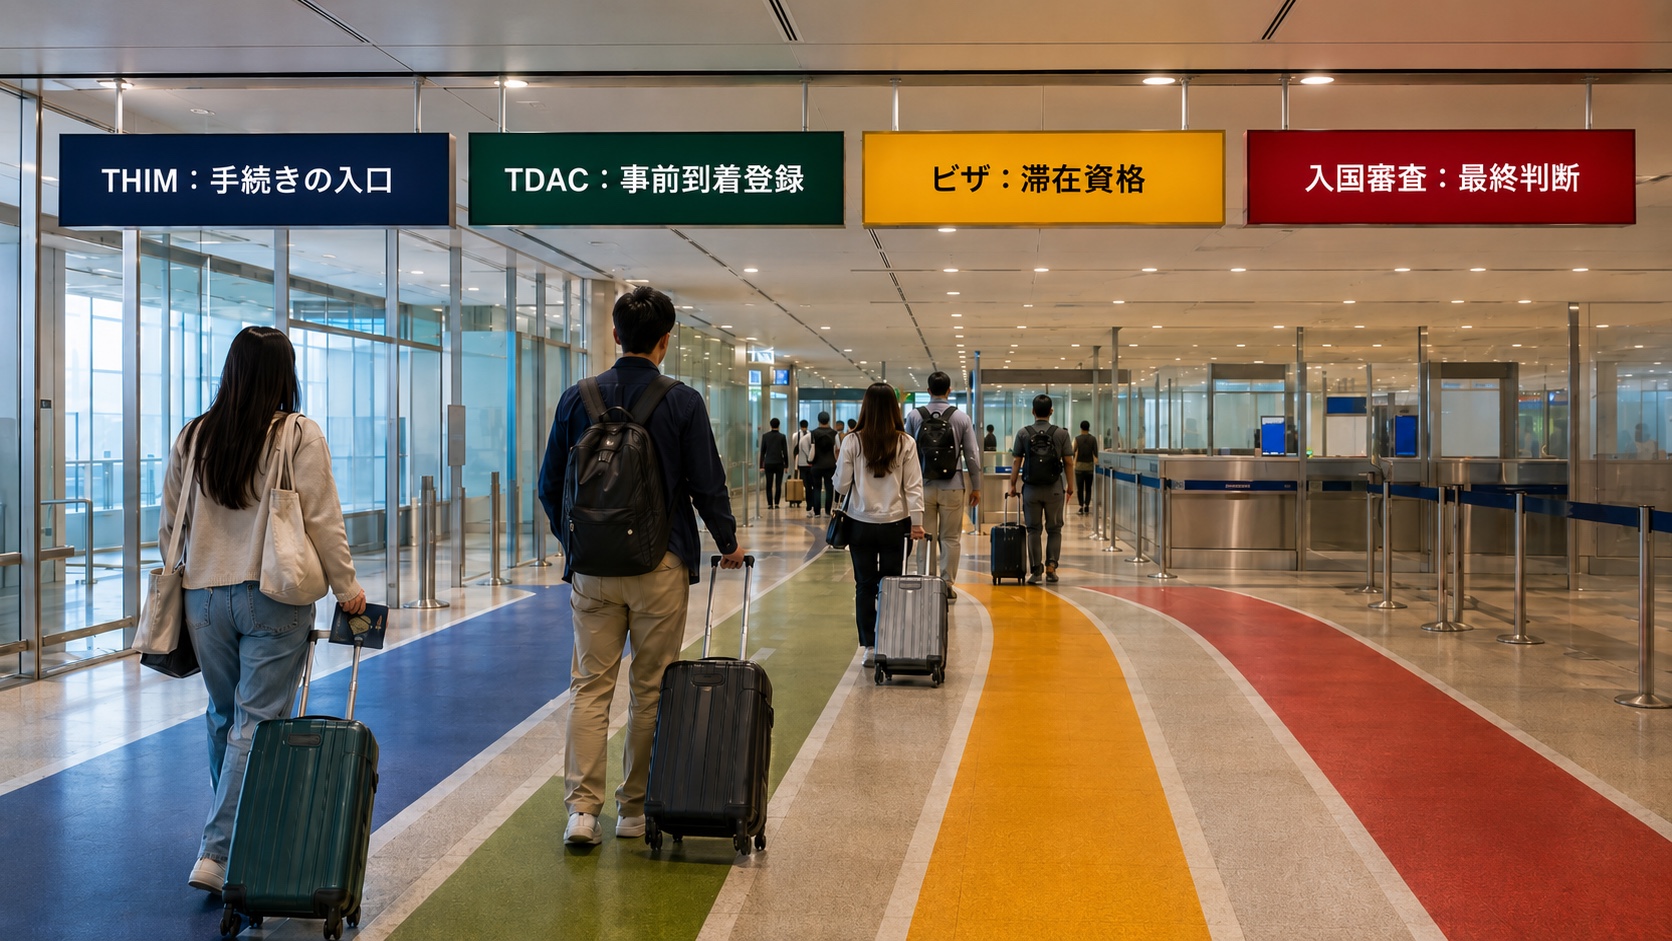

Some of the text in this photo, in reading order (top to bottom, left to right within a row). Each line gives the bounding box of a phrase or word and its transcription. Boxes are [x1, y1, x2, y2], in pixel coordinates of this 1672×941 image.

[933, 163, 1146, 194] ビザ：滞在資格
[1305, 162, 1580, 193] 入国審査：最終判断
